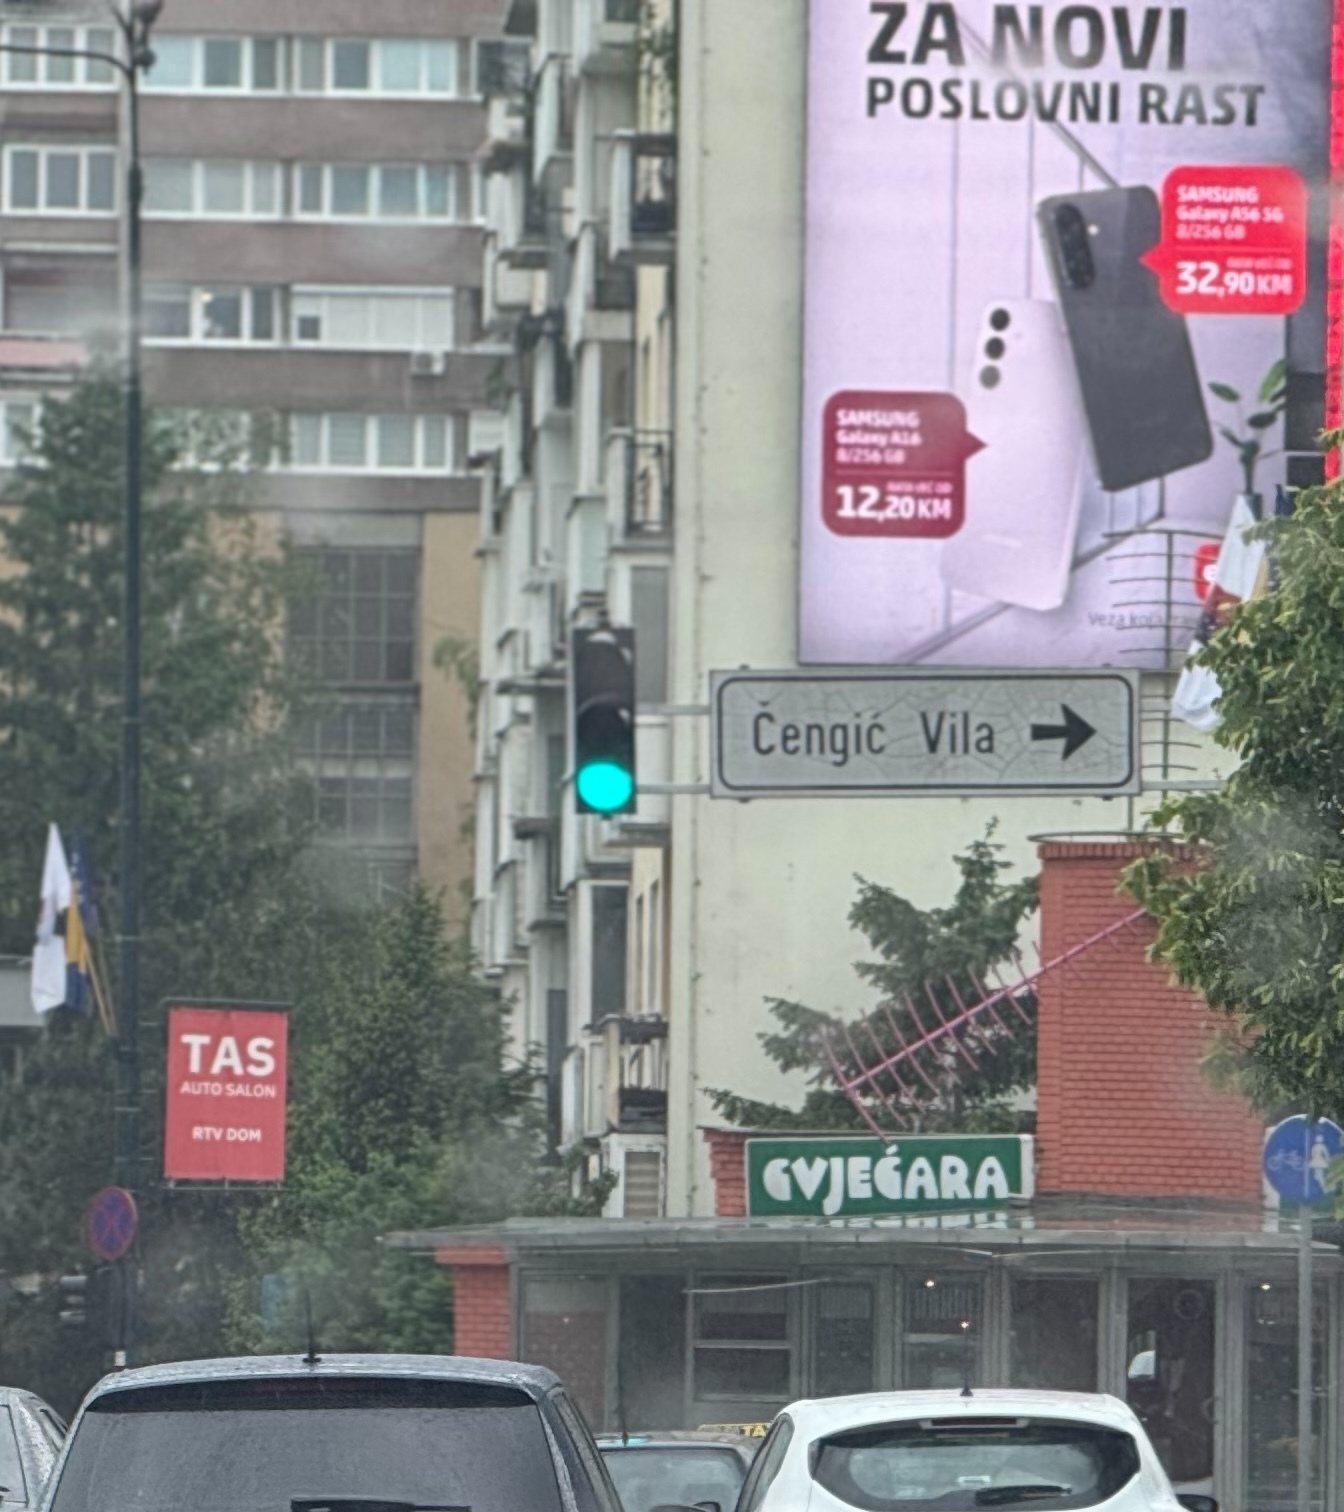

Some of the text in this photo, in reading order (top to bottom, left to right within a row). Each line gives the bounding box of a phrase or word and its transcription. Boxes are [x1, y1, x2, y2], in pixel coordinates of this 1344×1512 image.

[866, 1, 1189, 71] ZA NOVI
[866, 76, 1267, 127] POSLOVNI RAST
[1175, 185, 1259, 203] SAMSUNG
[1175, 205, 1229, 222] Galaxy
[1175, 260, 1256, 298] 32,90
[1257, 274, 1293, 296] KM
[836, 409, 921, 428] SAMSUNG
[835, 429, 889, 447] Galaxy
[835, 484, 953, 523] 12,20 KM
[752, 699, 996, 768] Čengić Vila
[179, 1033, 276, 1077] TAS
[179, 1080, 276, 1099] AUTO SALON
[192, 1126, 262, 1143] RTV DOM
